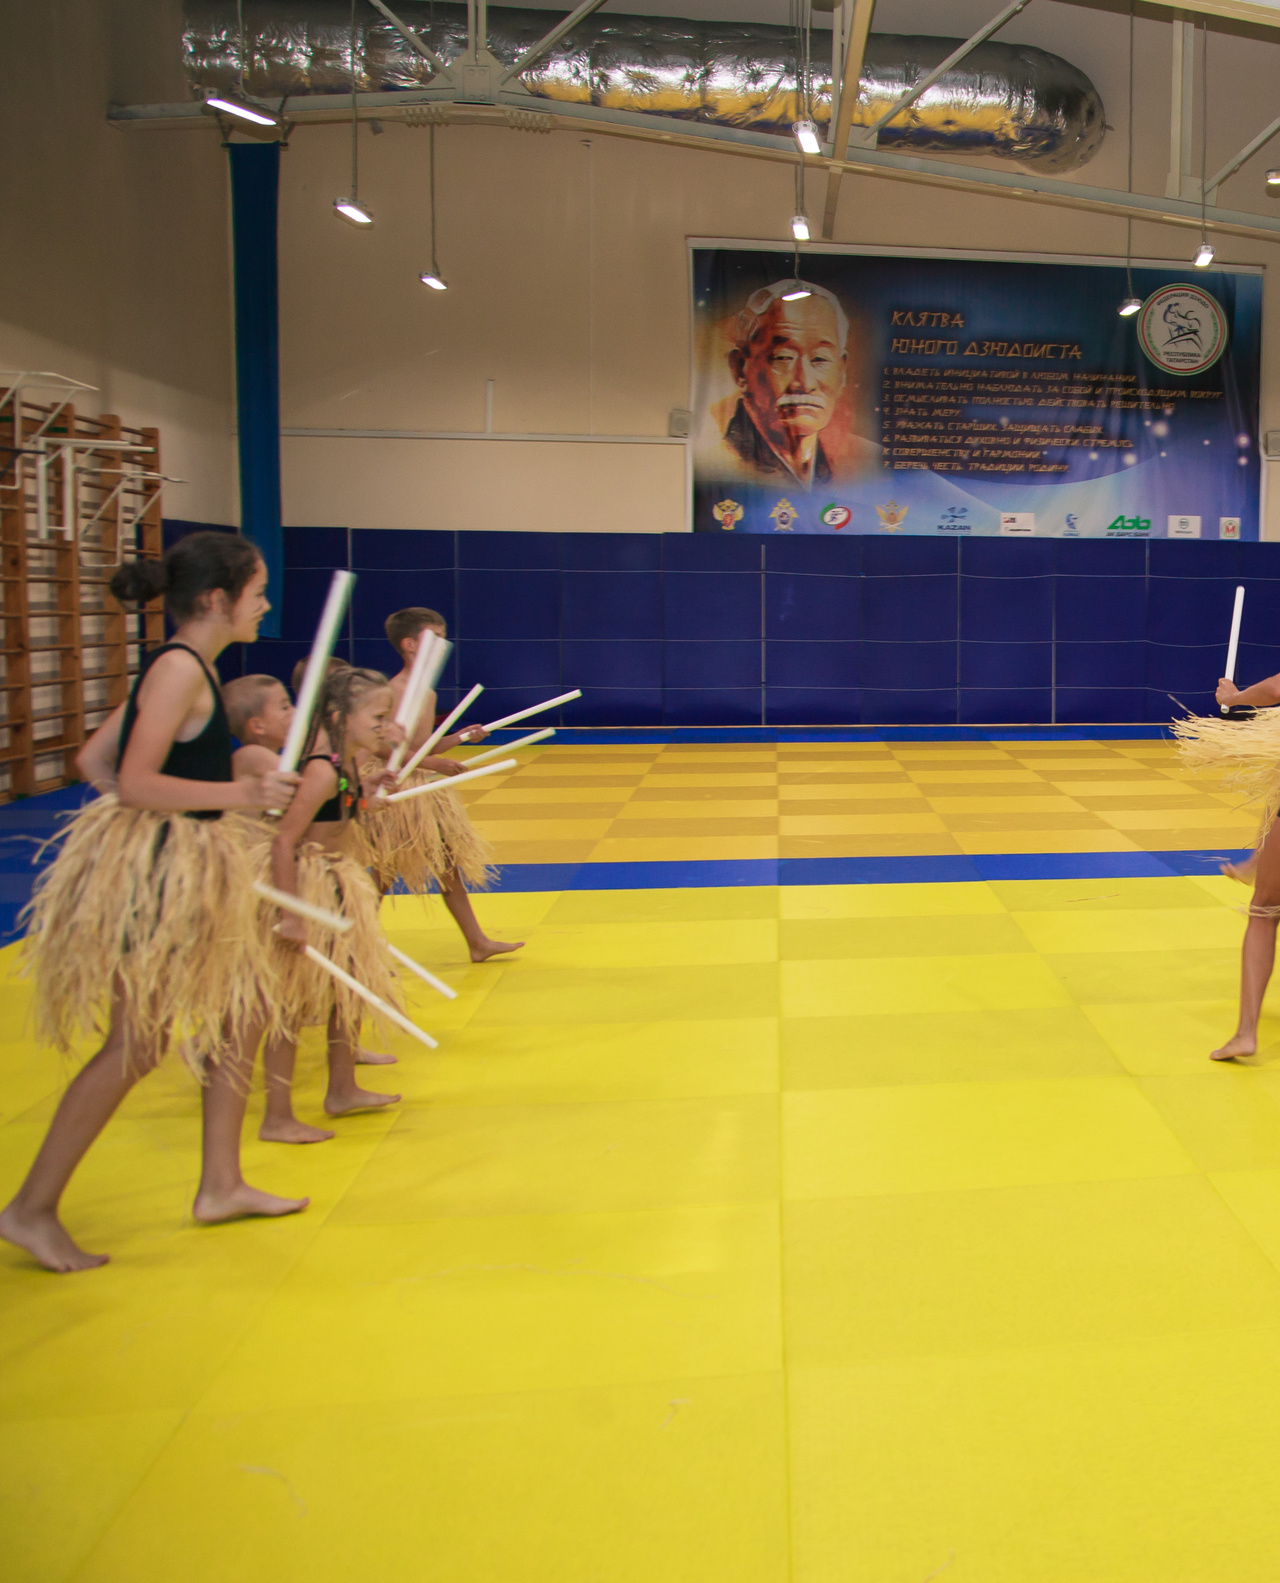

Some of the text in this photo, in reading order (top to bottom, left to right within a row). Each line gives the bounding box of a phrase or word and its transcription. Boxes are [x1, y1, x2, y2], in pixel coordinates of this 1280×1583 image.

[891, 310, 965, 328] КЛЯТВА
[891, 338, 1083, 360] ЮНОГО ДЗЮДОИСТА
[892, 368, 940, 376] ВЛАДЕТЬ
[943, 368, 1020, 380] ИНИЦИАТИВОЙ
[1022, 371, 1027, 379] В
[1030, 372, 1068, 380] ЛЮБОМ
[894, 381, 974, 391] ВНИМАТЕЛЬНО
[977, 382, 1042, 392] НАБЛЮДАТЬ
[1062, 386, 1092, 394] СОБОЙ
[1105, 387, 1187, 398] ПРОИСХОДЯЩИМ
[893, 394, 968, 404] ОСМЫСЛИВАТЬ
[1038, 397, 1106, 408] ДЕЙСТВОВАТЬ
[894, 408, 928, 416] ЗНАТЬ
[895, 421, 944, 430] УВАЖАТЬ
[1001, 424, 1060, 435] ЗАЩИЩАТЬ
[894, 434, 962, 444] РАЗВИВАТЬСЯ
[964, 436, 1012, 445] ДУХОВНО
[892, 448, 971, 457] СОВЕРШЕНСТВУ
[972, 449, 980, 457] И
[894, 461, 928, 470] БЕРЕЧЬ
